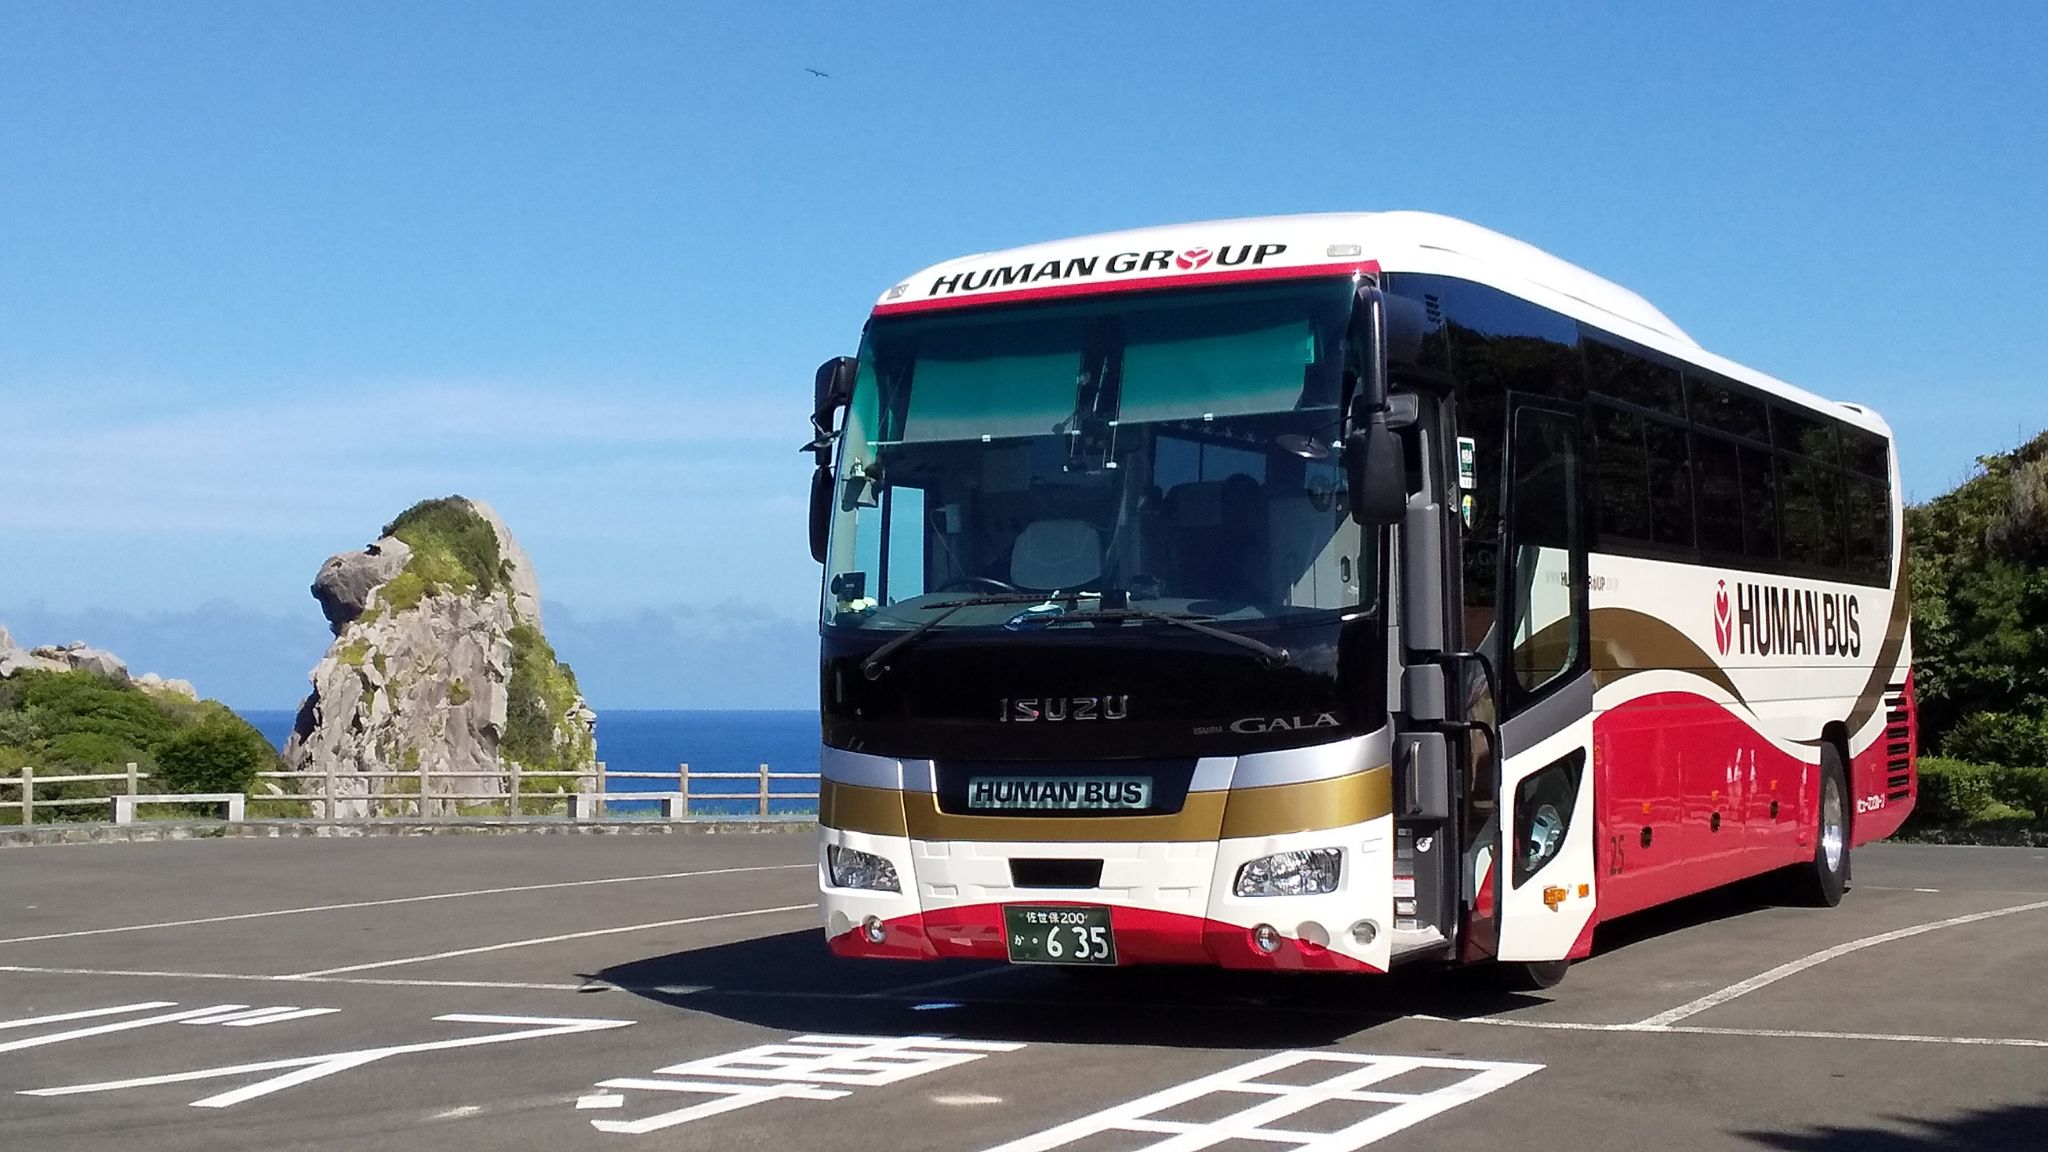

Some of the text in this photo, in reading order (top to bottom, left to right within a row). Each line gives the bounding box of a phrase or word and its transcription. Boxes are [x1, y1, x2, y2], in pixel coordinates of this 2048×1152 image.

[929, 256, 1099, 296] HUMAN
[1737, 582, 1861, 658] HUMAN BUS
[1000, 695, 1128, 722] ISUZU
[1230, 711, 1341, 734] GALA
[975, 781, 1142, 804] HUMAN BUS
